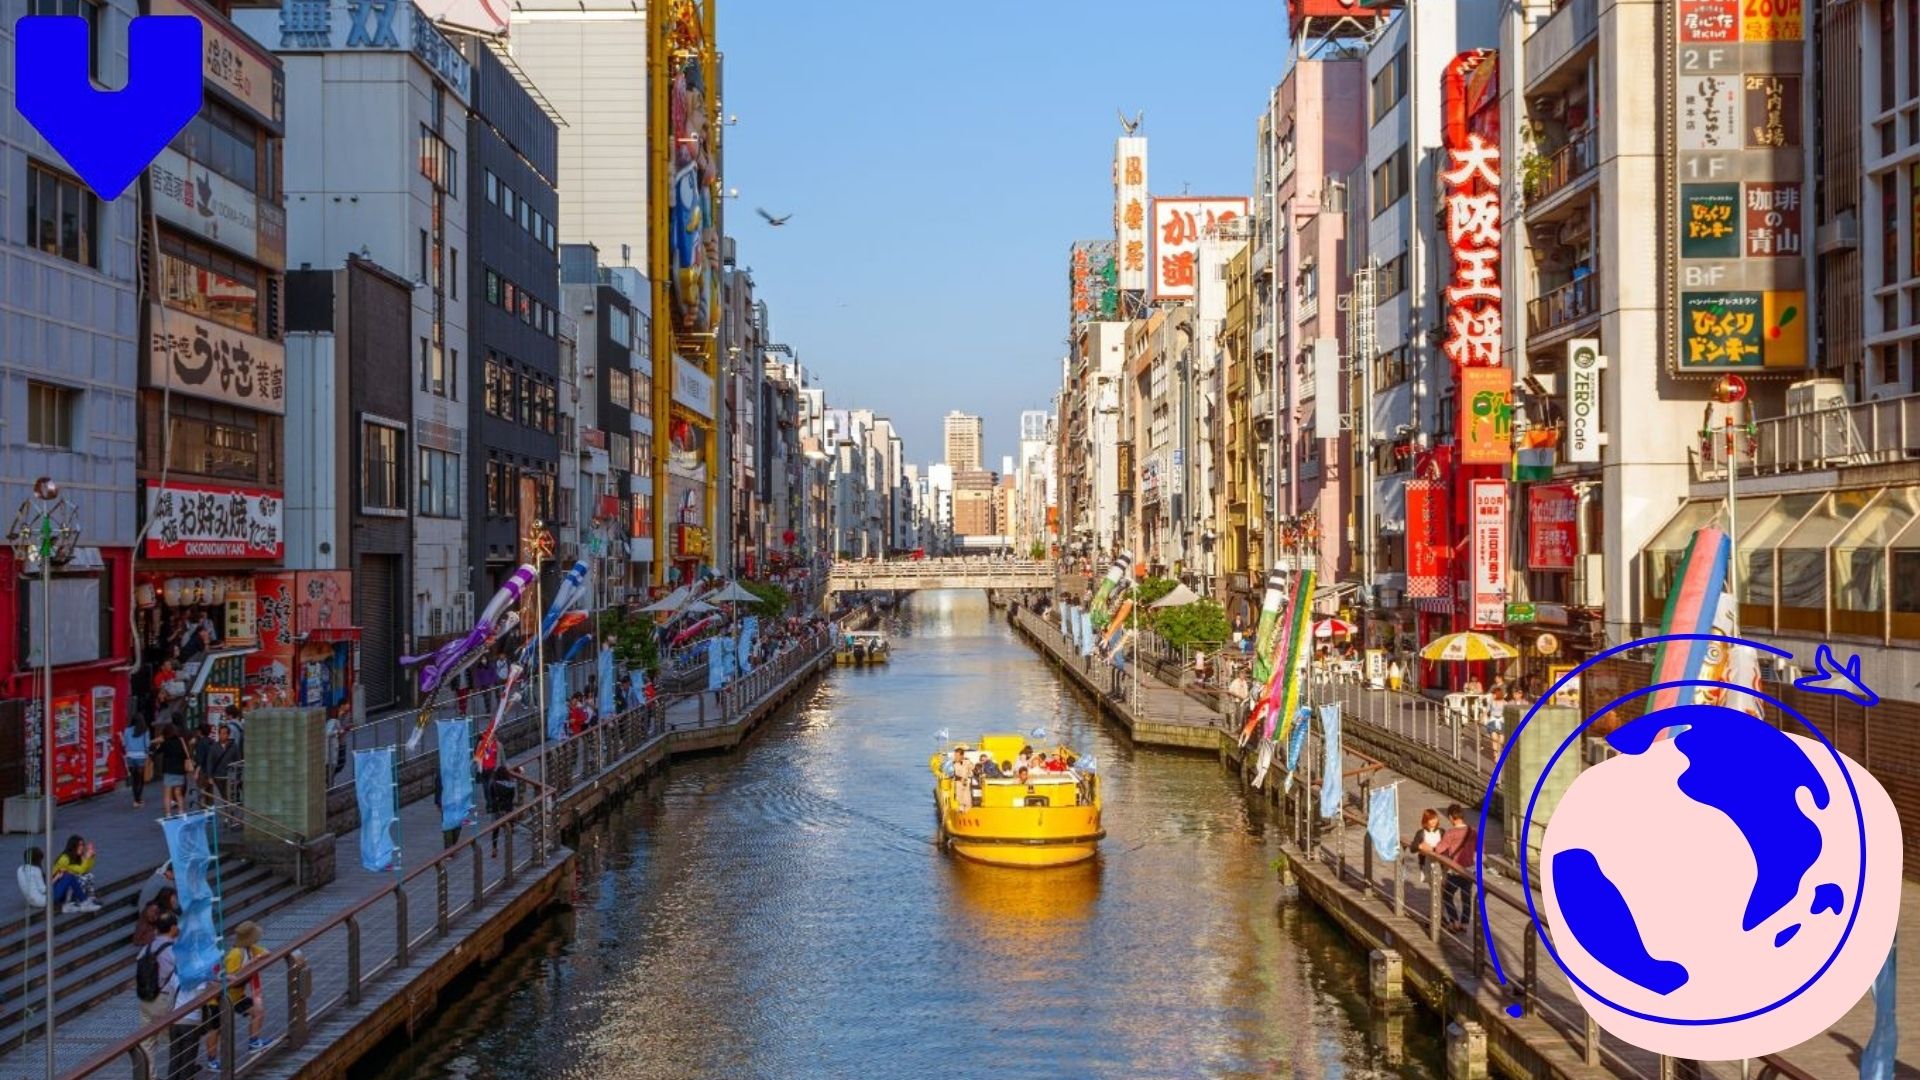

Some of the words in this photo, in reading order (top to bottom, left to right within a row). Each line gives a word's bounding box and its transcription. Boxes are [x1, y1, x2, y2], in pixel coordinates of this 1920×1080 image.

[1746, 76, 1764, 90] 2F
[1747, 186, 1800, 211] 珈琲
[1691, 203, 1732, 222] びっくり
[1764, 212, 1783, 228] の
[1688, 222, 1734, 239] ドンキー
[1748, 228, 1800, 254] 青山
[1445, 134, 1500, 366] 大阪王将
[1688, 297, 1759, 306] ハンバーグレストラン
[1691, 310, 1755, 338] びっくり
[174, 324, 255, 398] うなぎ
[1687, 336, 1760, 363] ドンキー
[1575, 372, 1591, 417] ZERO
[1575, 417, 1587, 450] cafe
[179, 492, 248, 539] お好み焼
[185, 542, 245, 556] OKONOMIYAKI
